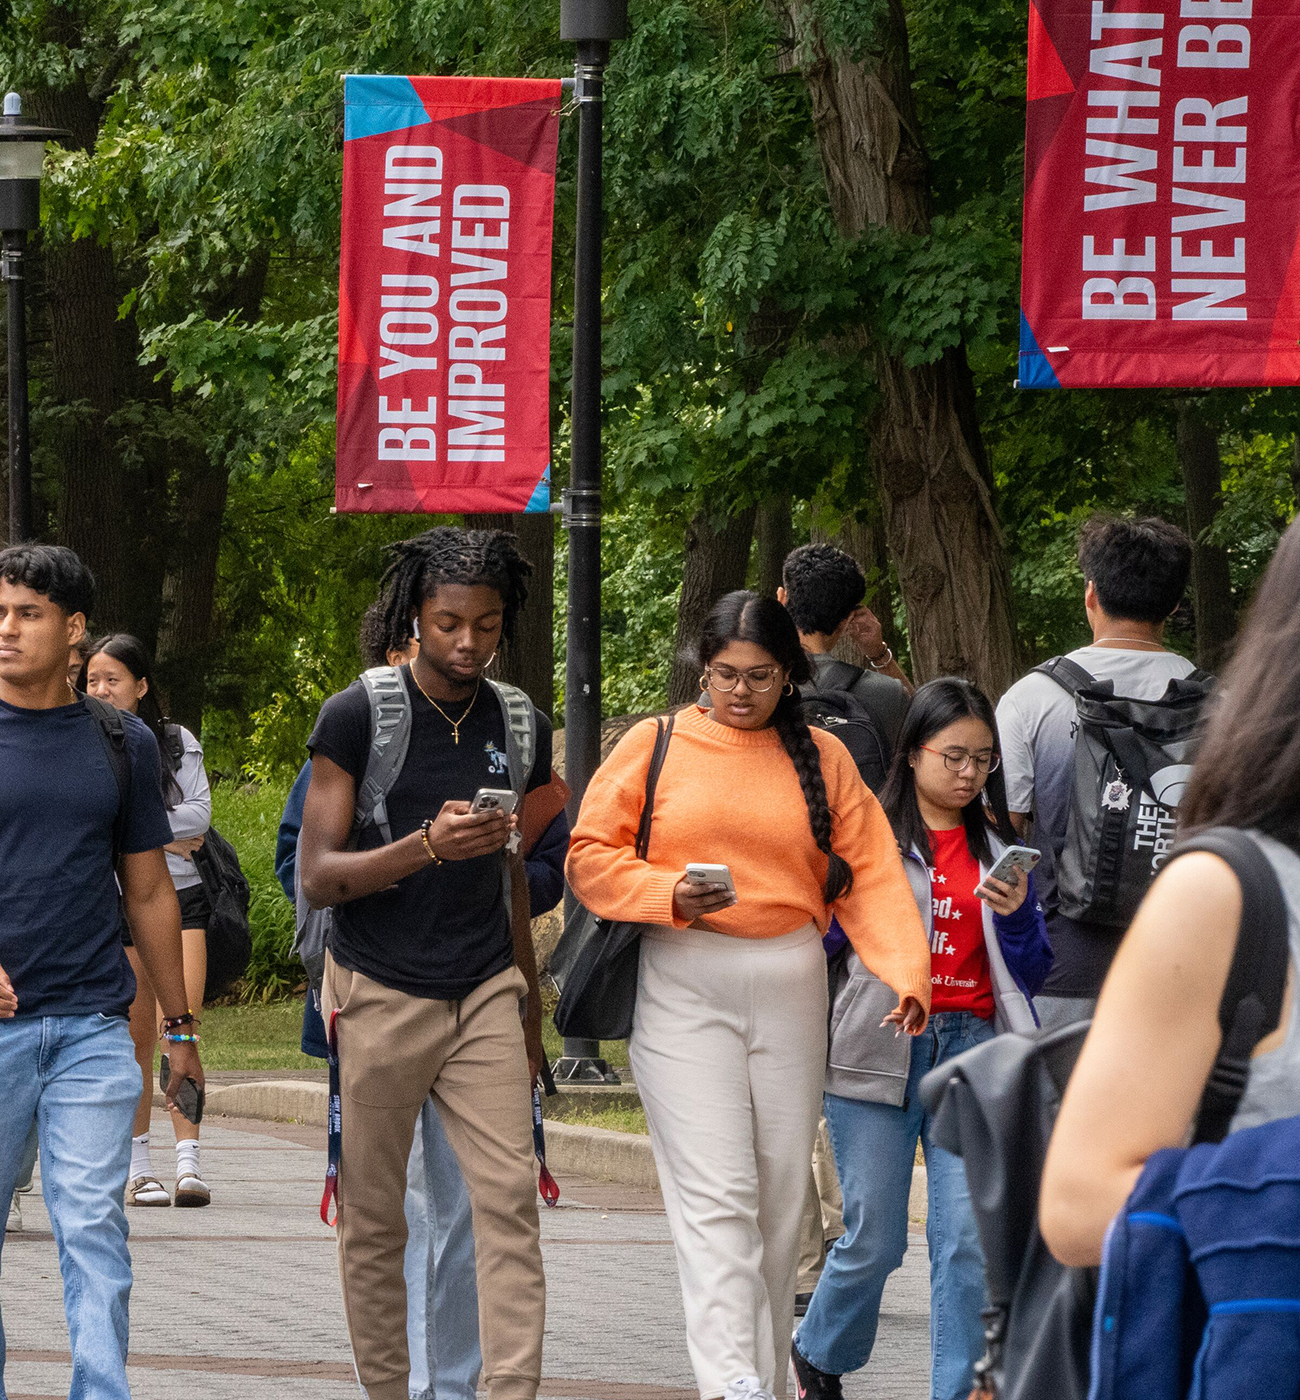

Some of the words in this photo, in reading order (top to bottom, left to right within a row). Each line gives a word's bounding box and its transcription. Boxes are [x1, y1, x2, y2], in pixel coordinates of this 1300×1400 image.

[1084, 0, 1165, 212] WHAT
[382, 145, 443, 257] AND
[1171, 96, 1249, 321] NEVER
[379, 274, 440, 380] YOU
[447, 184, 511, 462] IMPROVED
[1082, 235, 1156, 321] BE
[378, 395, 437, 461] BE
[1133, 805, 1158, 851] THE
[1150, 806, 1177, 877] ORTH
